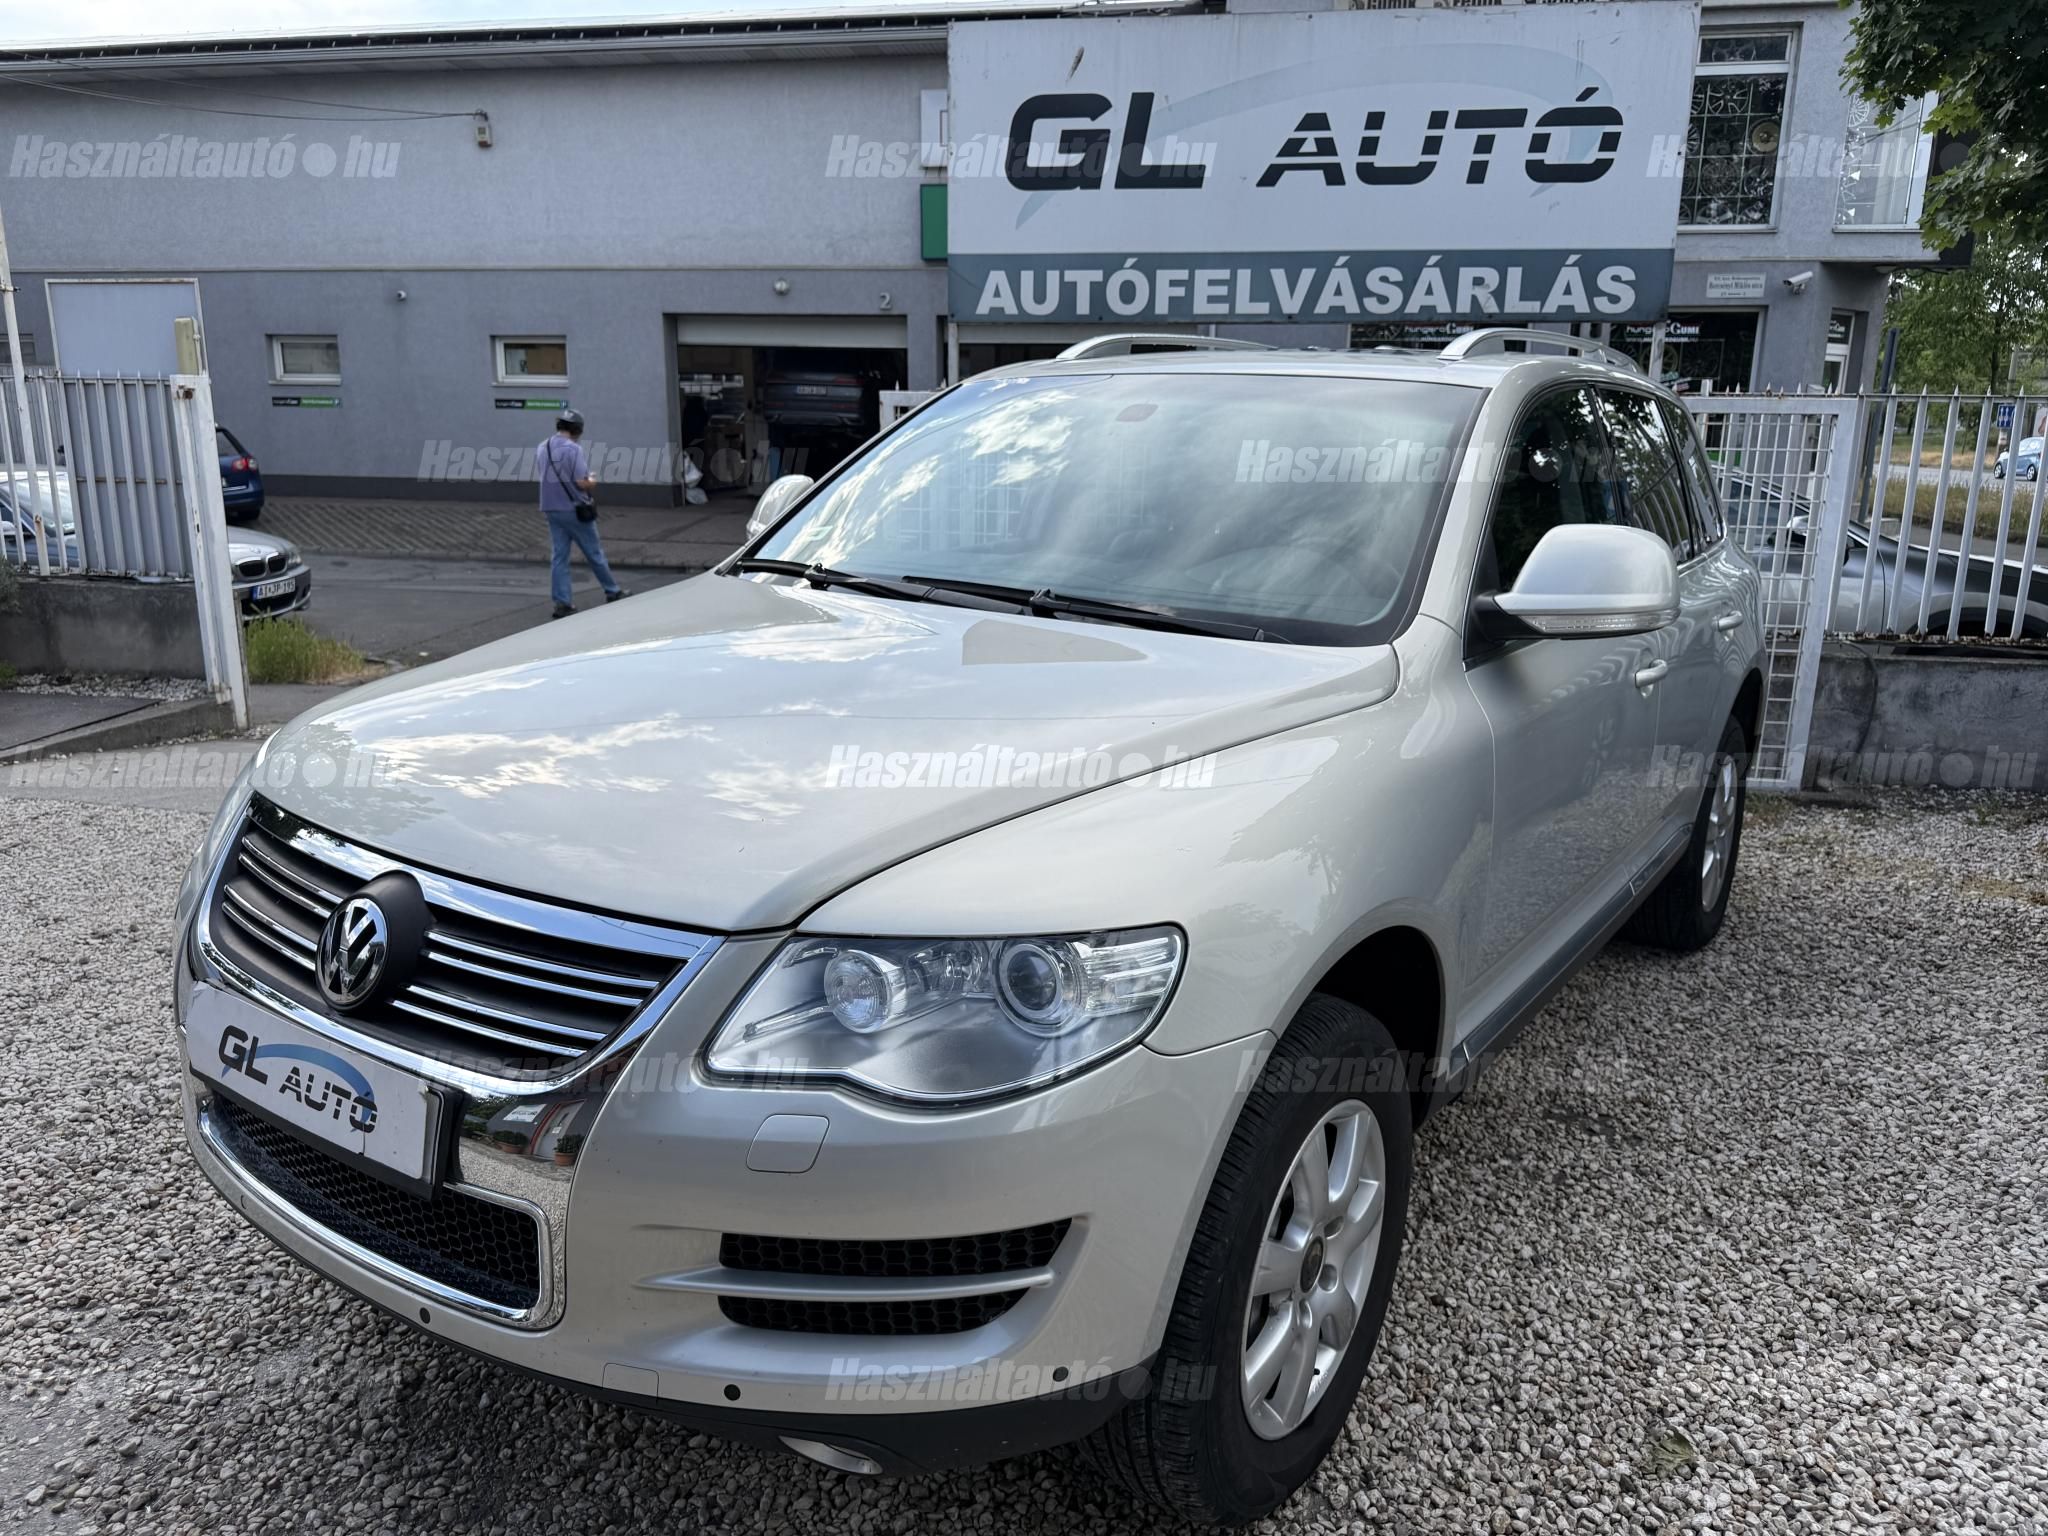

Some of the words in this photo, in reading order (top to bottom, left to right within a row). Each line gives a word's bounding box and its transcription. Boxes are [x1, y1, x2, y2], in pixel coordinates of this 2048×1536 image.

[1003, 91, 1206, 191] GL
[1255, 86, 1624, 188] AUTÓ
[879, 291, 891, 310] 2
[975, 255, 1638, 318] AUTÓFELVÁSÁRLÁS
[218, 1024, 268, 1086] GL
